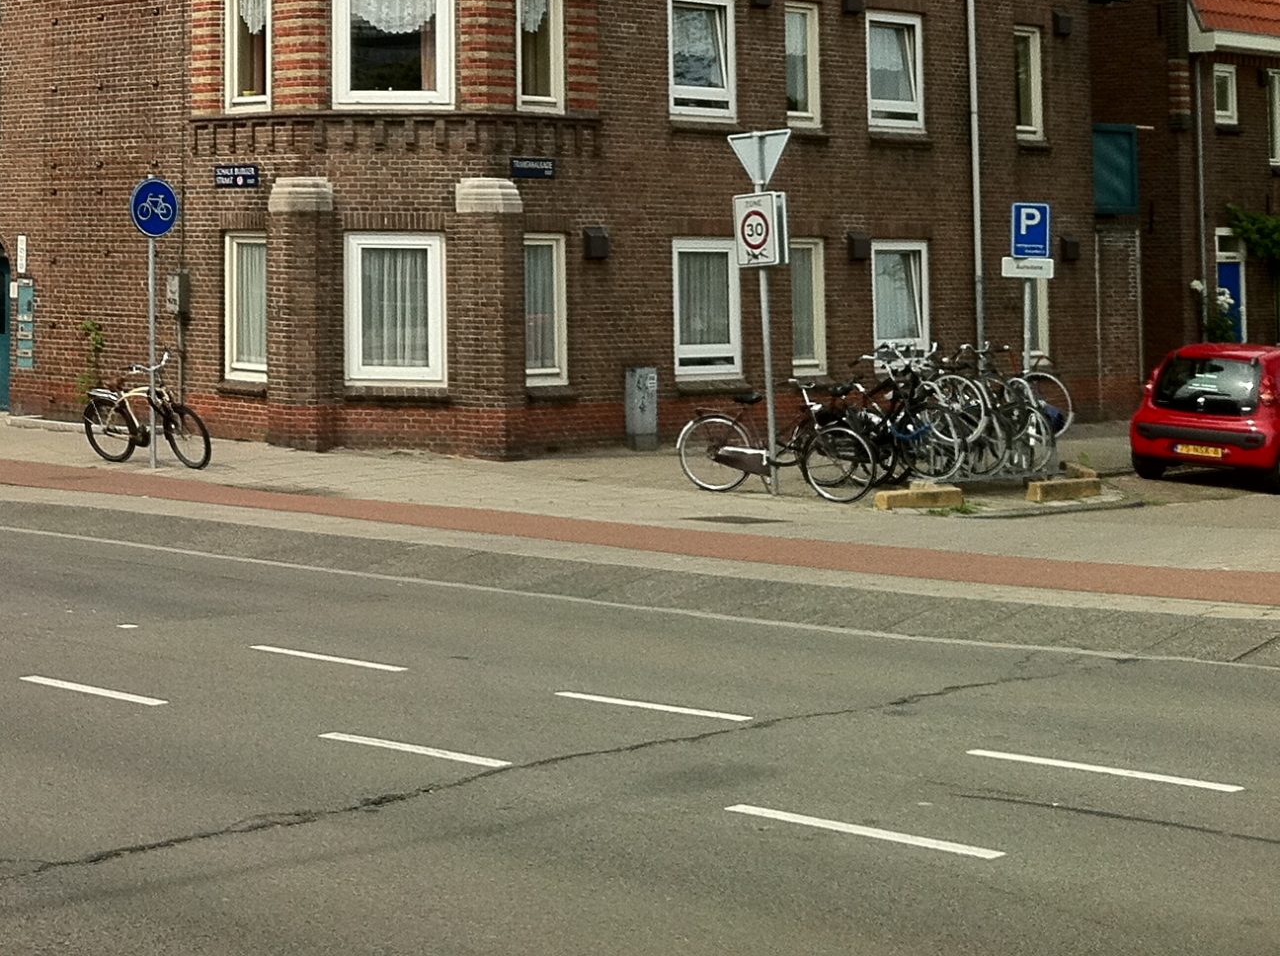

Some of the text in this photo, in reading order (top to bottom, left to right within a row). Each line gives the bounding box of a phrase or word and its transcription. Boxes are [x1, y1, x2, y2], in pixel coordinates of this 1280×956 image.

[745, 199, 762, 208] ZONE
[1020, 207, 1041, 235] P
[746, 222, 764, 237] 30
